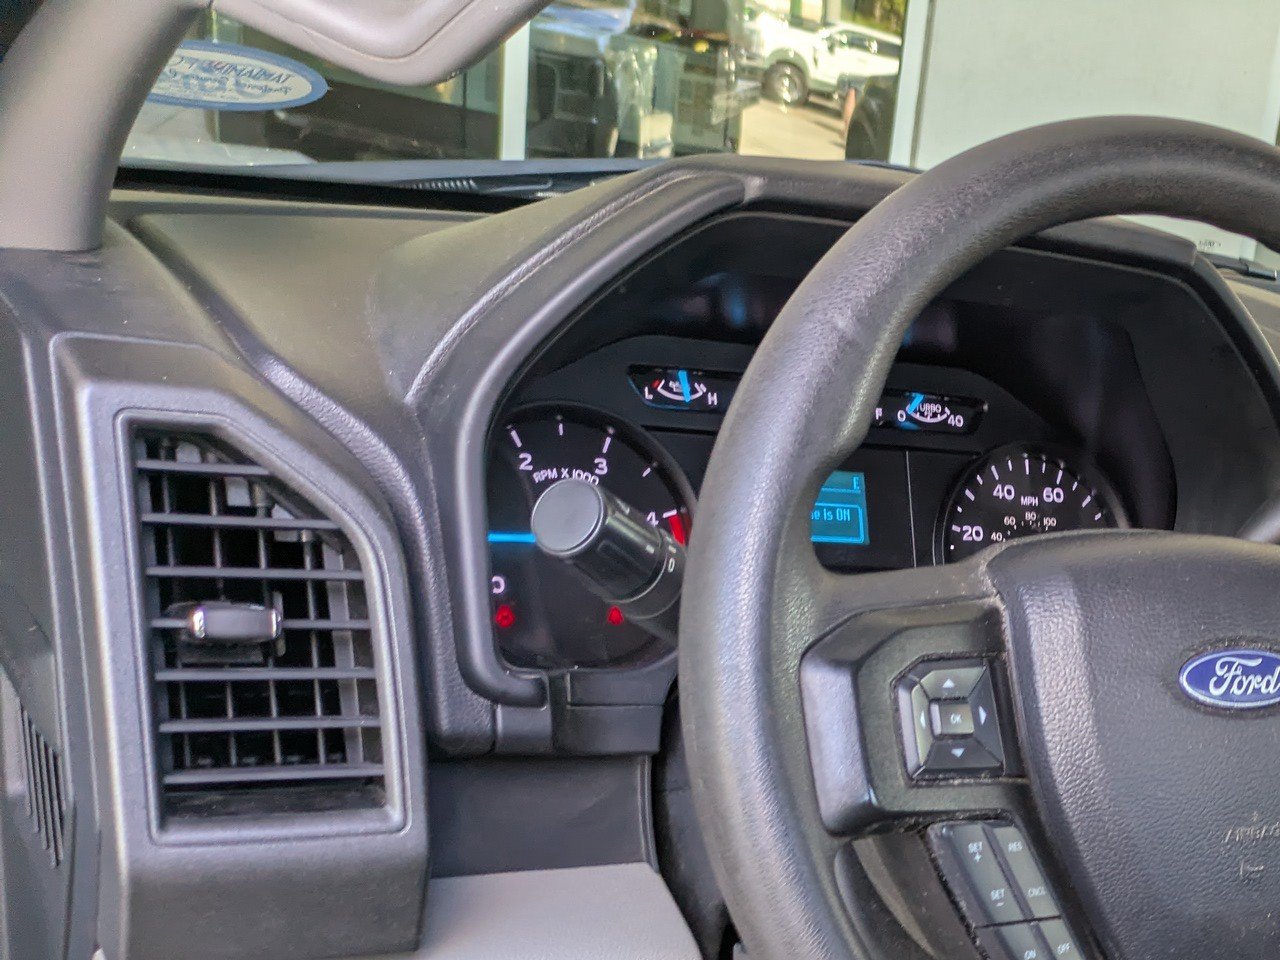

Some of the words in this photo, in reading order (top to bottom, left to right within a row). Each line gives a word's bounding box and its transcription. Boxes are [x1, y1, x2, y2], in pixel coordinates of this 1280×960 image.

[644, 386, 653, 400] L
[707, 391, 718, 406] H
[915, 402, 942, 414] TURBO
[947, 413, 964, 428] 40
[518, 452, 534, 471] 2
[593, 457, 609, 475] 3
[532, 467, 558, 485] RPM
[560, 467, 570, 479] X
[571, 468, 600, 486] 1000
[992, 484, 1015, 501] 40
[1042, 487, 1064, 504] 60
[1020, 495, 1039, 507] MPH
[1003, 515, 1016, 526] 60
[1025, 511, 1037, 521] 80
[1043, 516, 1057, 527] 100
[962, 525, 984, 542] 20
[990, 531, 1003, 542] 40
[1208, 656, 1280, 696] Ford
[968, 841, 983, 853] SET
[990, 889, 1005, 901] SET
[1024, 950, 1037, 960] ON
